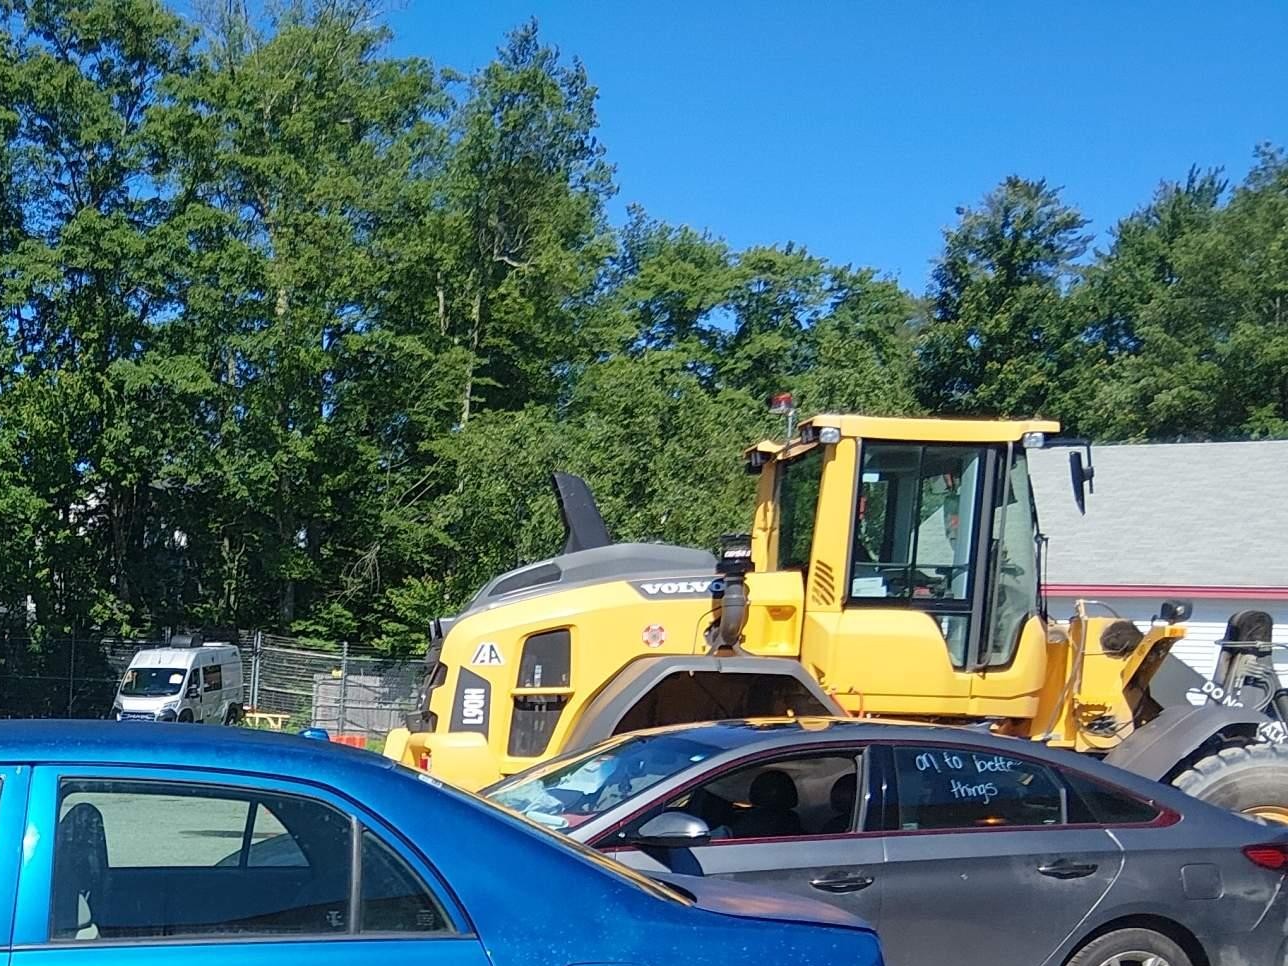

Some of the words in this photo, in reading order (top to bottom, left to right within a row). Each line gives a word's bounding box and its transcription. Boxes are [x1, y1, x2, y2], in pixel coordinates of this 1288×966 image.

[641, 579, 726, 595] VOLVO
[943, 751, 963, 769] to
[951, 779, 998, 805] things
